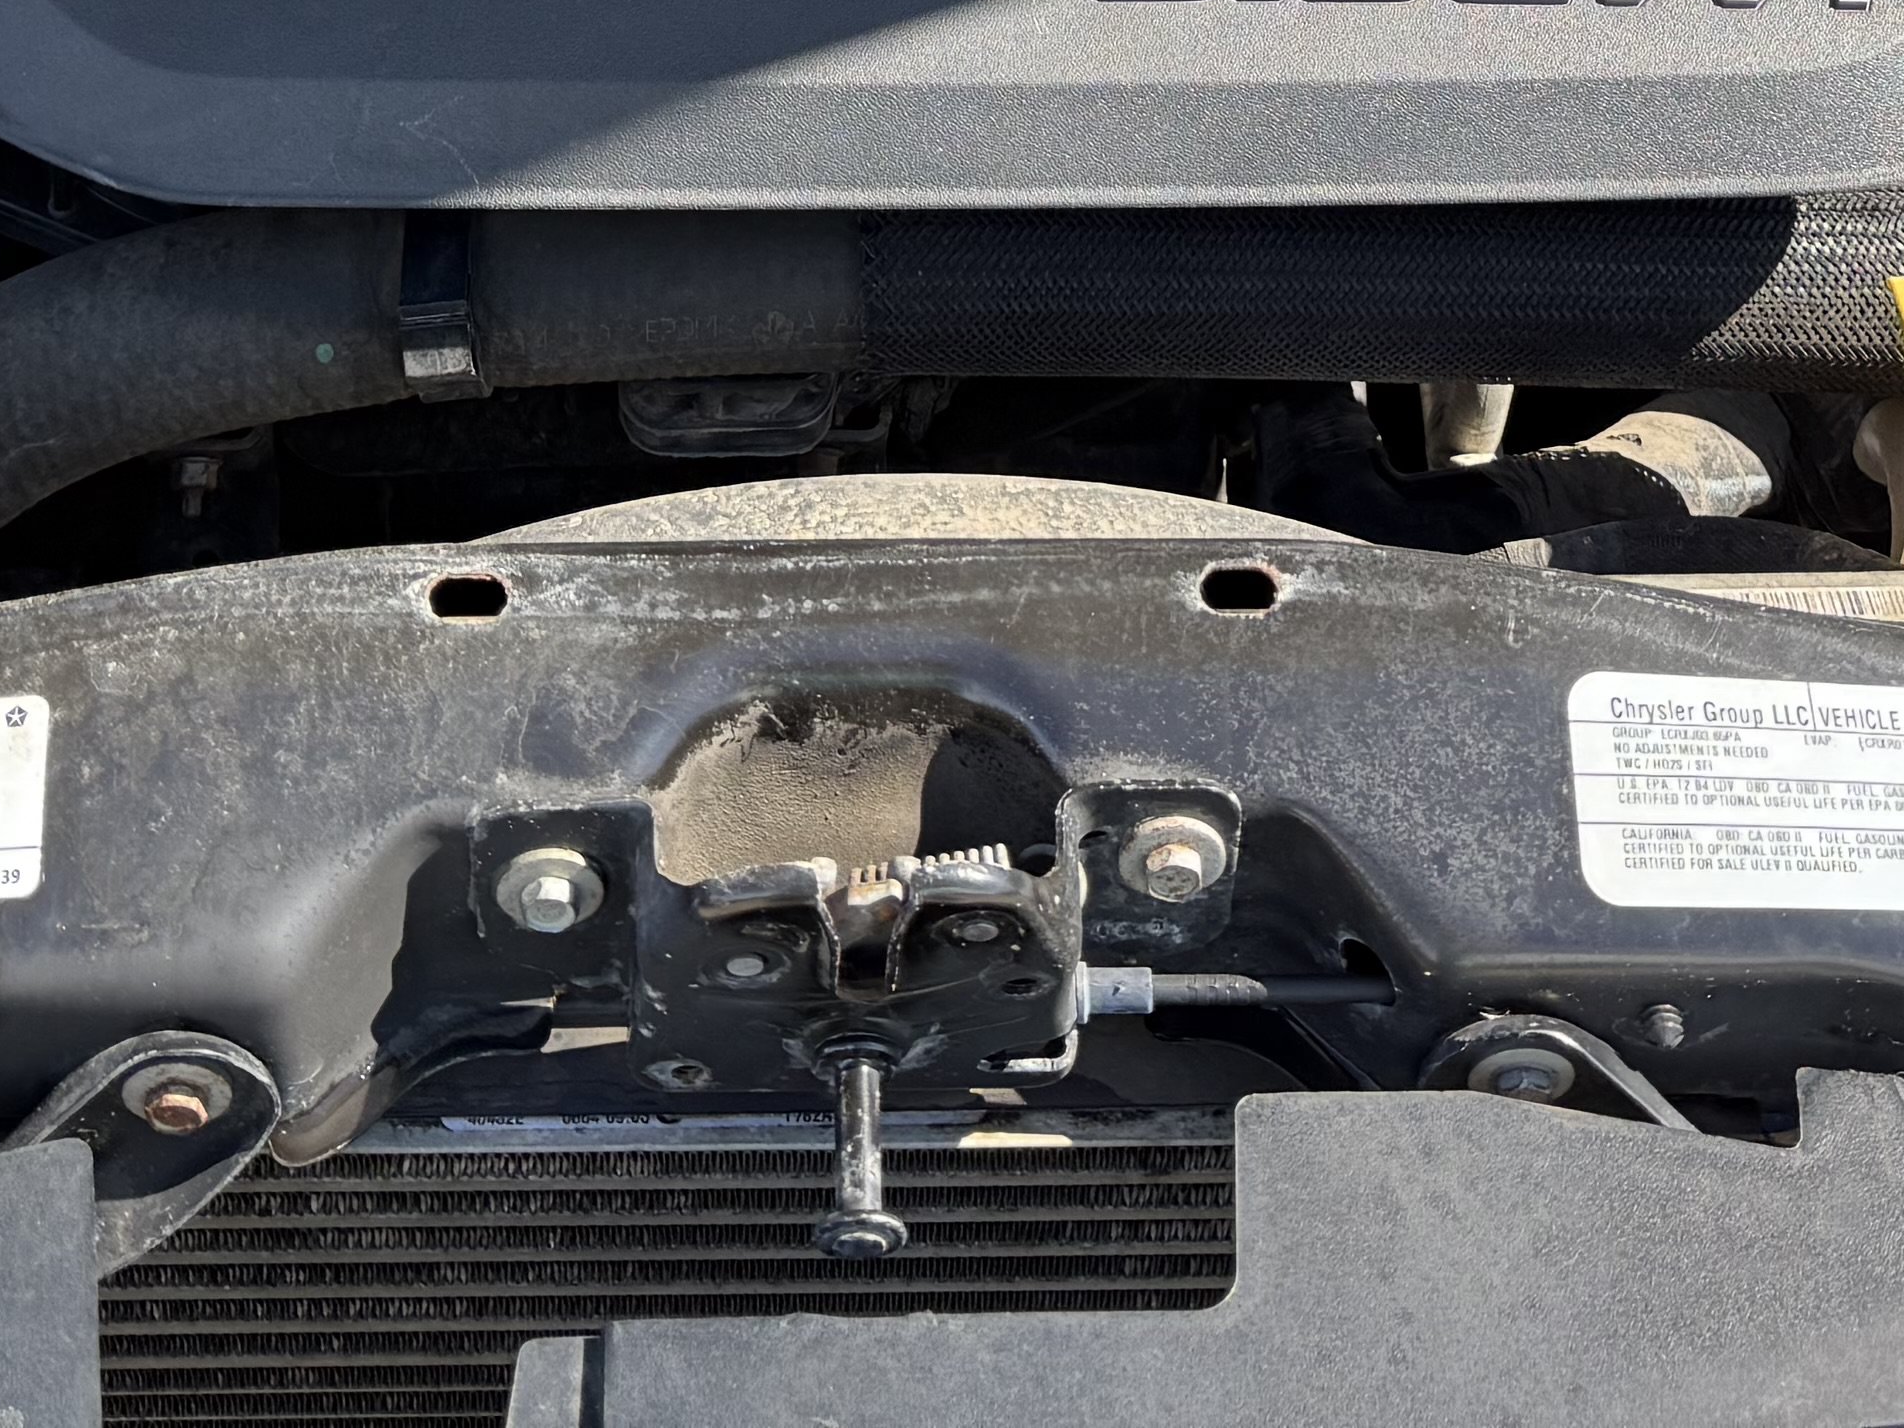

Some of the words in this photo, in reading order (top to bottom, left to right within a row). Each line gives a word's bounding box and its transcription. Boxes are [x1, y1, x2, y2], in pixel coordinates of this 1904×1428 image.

[1610, 697, 1694, 725] Chrysler
[1703, 701, 1764, 728] Group
[1772, 704, 1810, 727] LLC
[1818, 706, 1901, 732] VEHICLE
[1635, 743, 1719, 757] ADJUSTMENTS
[1723, 746, 1769, 758] NEEDED
[1618, 793, 1679, 806] CERTIFIED
[1702, 794, 1761, 807] OPTIONAL
[1624, 842, 1684, 855] CERTIFIED
[1708, 843, 1766, 857] OPTIONAL
[1770, 845, 1816, 858] USEFUL
[1624, 857, 1685, 870] CERTIFIED
[1690, 857, 1713, 870] FOR
[1718, 858, 1746, 871] SALE
